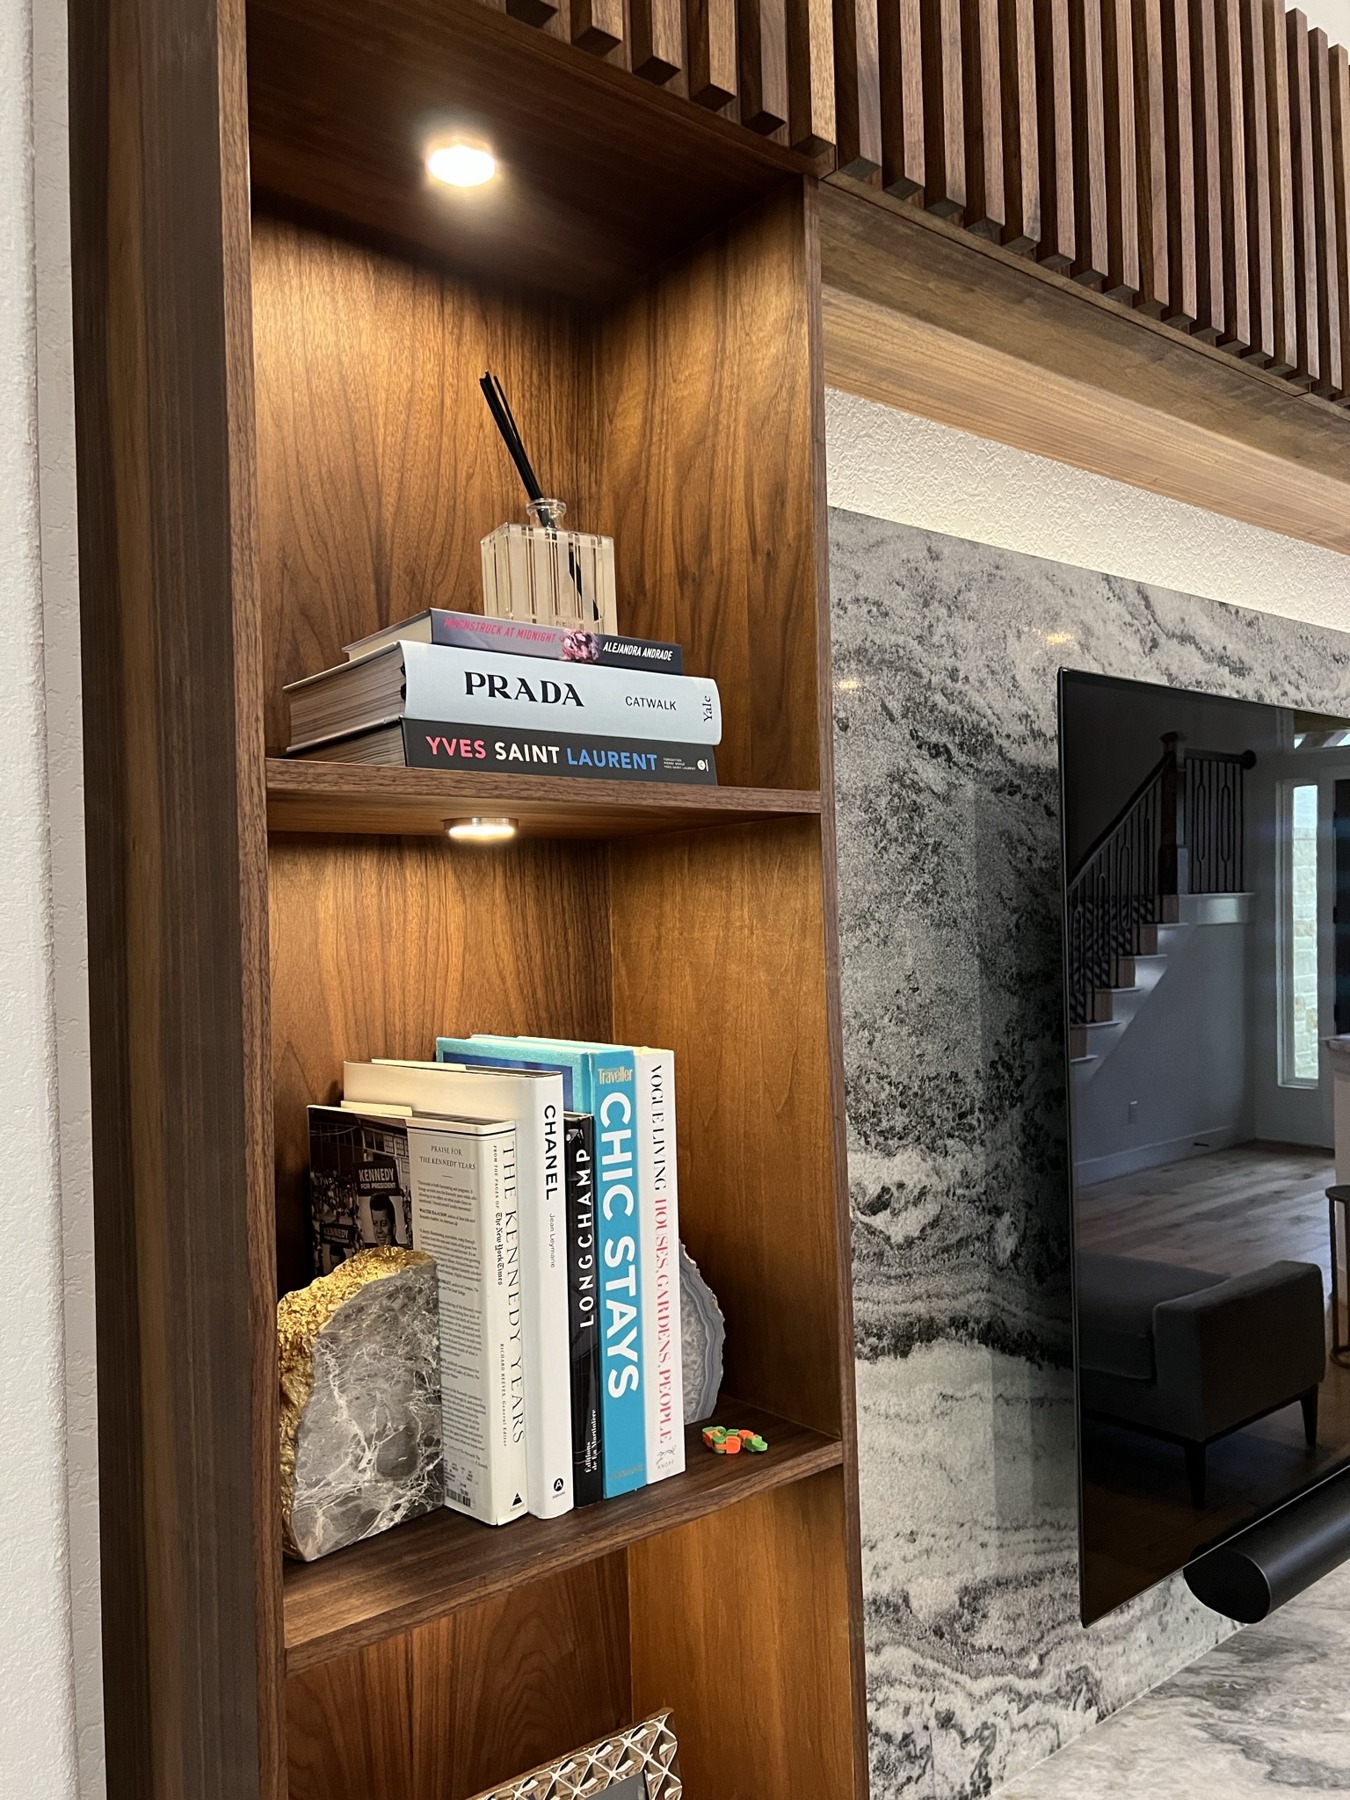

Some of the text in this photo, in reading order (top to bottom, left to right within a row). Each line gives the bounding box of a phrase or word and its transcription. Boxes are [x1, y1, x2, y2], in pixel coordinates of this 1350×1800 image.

[444, 616, 557, 643] MOONSTRUCK AT MIDNIGHT
[602, 641, 674, 661] ALEJANDRA ANDRADE
[464, 671, 677, 711] PRADA CATWALK
[702, 695, 713, 722] Yale
[425, 736, 658, 771] YVES SAINT LAURENT
[598, 1066, 634, 1085] Traveller
[650, 1065, 667, 1190] VOGUE LIVING
[419, 1156, 476, 1171] THE KENNEDY YEARS
[430, 1145, 462, 1156] PRAISE FOR
[544, 1105, 558, 1200] CHANEL
[358, 1167, 395, 1182] KENNEDY
[495, 1200, 500, 1208] OF
[323, 1227, 349, 1239] KENNEDY
[575, 1149, 595, 1328] LONGCHAMP
[600, 1092, 640, 1399] CHIC STAYS
[495, 1212, 505, 1286] The New York Times
[503, 1141, 524, 1444] THE KENNEDY YEARS
[658, 1369, 672, 1444] PEOPLE
